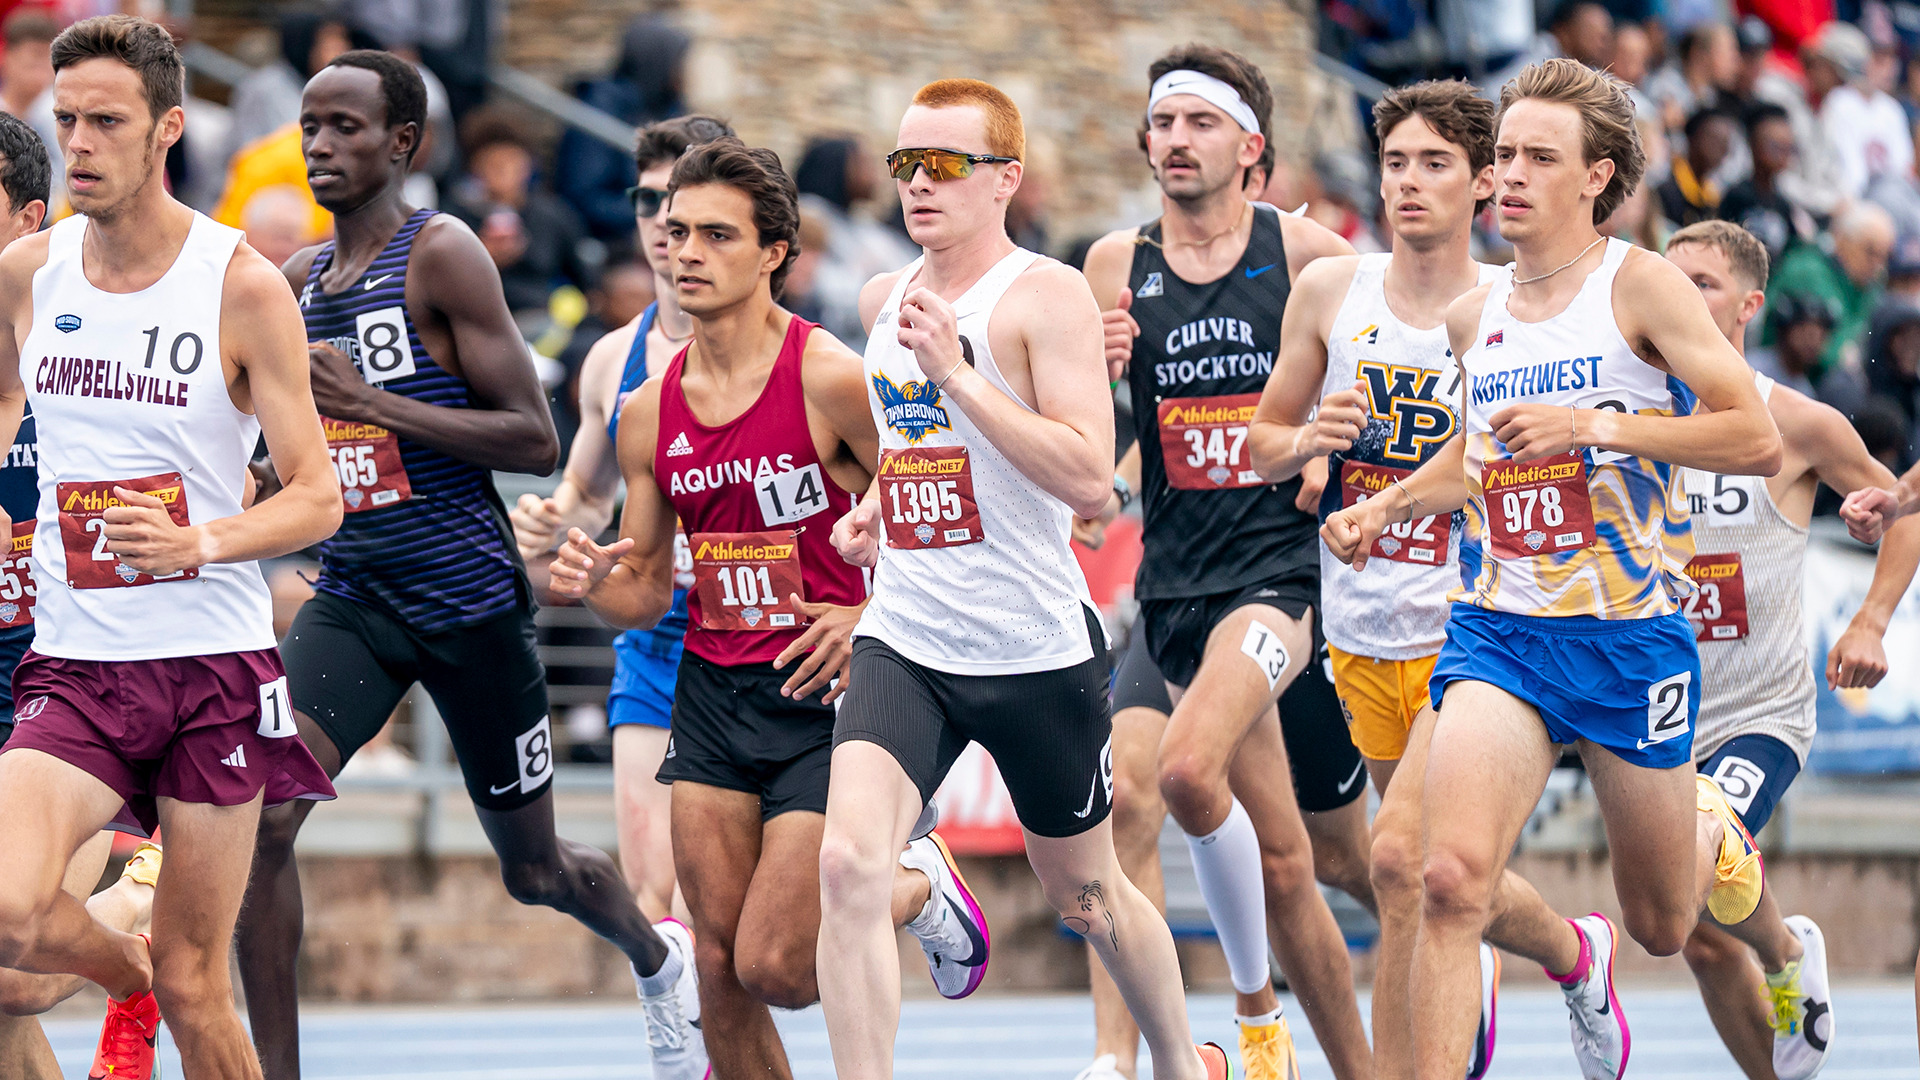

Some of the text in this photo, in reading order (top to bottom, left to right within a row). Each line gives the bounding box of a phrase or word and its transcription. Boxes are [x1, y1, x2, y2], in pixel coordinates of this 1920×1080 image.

[142, 326, 203, 375] 10
[363, 322, 403, 372] 8
[1166, 317, 1256, 355] CULVER
[36, 356, 188, 407] CAMPBELLSVILLE
[1155, 352, 1273, 386] STOCKTON
[1472, 356, 1603, 406] NORTHWEST
[904, 403, 947, 425] BROWN
[666, 446, 694, 457] adidas
[1184, 427, 1249, 467] 347
[671, 454, 795, 496] AQUINAS
[762, 471, 823, 517] 14
[1713, 475, 1749, 516] 5
[889, 481, 963, 524] 1395
[1502, 486, 1565, 534] 978
[717, 566, 779, 607] 101
[1256, 630, 1285, 680] 13
[1654, 682, 1686, 732] 2
[525, 729, 549, 777] 8
[1719, 762, 1759, 798] 5
